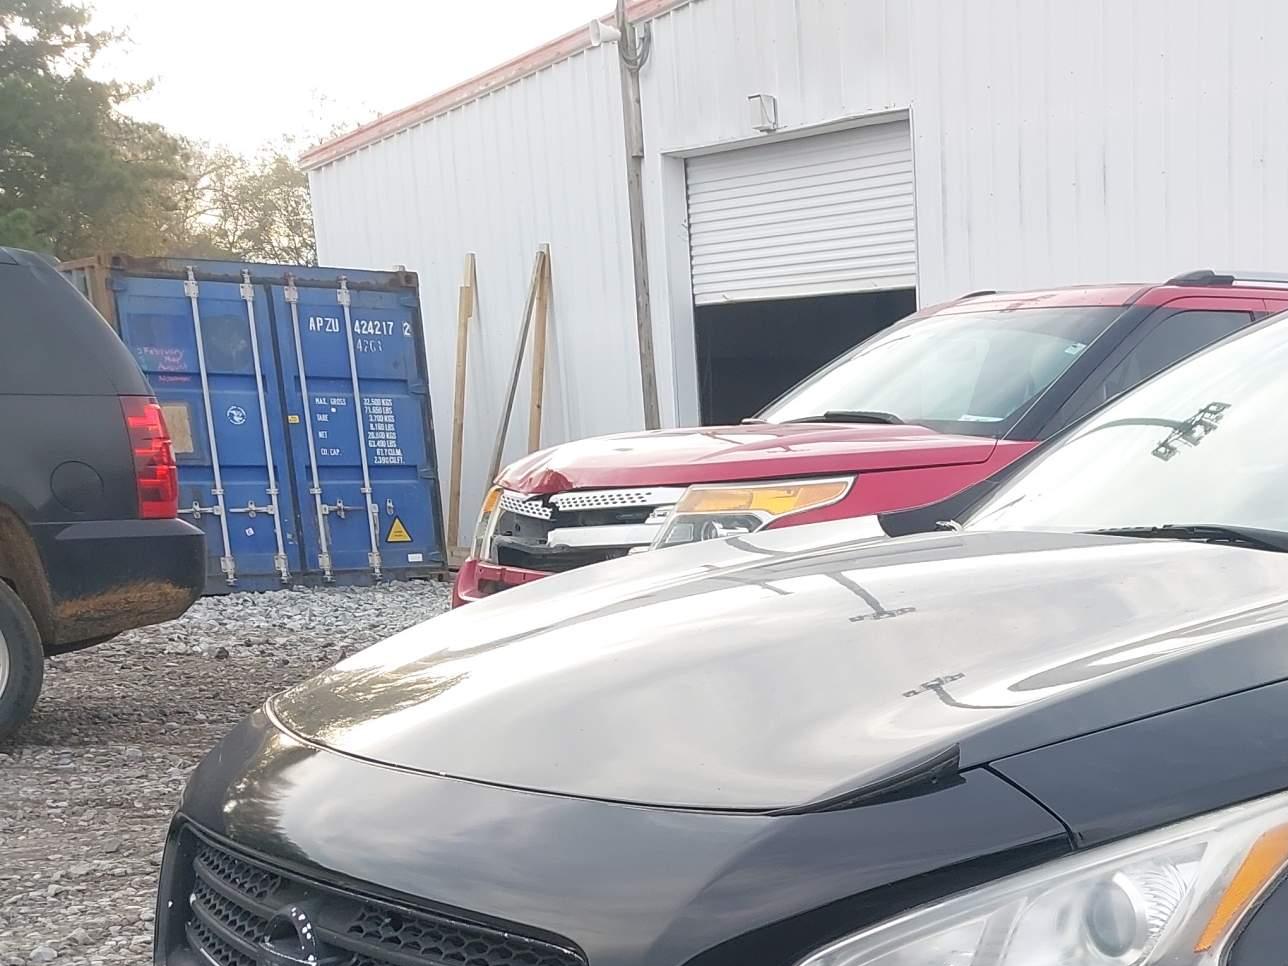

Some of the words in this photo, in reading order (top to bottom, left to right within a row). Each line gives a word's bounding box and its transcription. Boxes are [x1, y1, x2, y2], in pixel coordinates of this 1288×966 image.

[309, 317, 340, 332] APZU
[354, 319, 394, 336] 424217
[403, 322, 411, 336] 2
[330, 398, 346, 406] GROSS
[382, 398, 393, 406] KGS
[385, 423, 395, 431] LBS
[318, 431, 328, 439] NET
